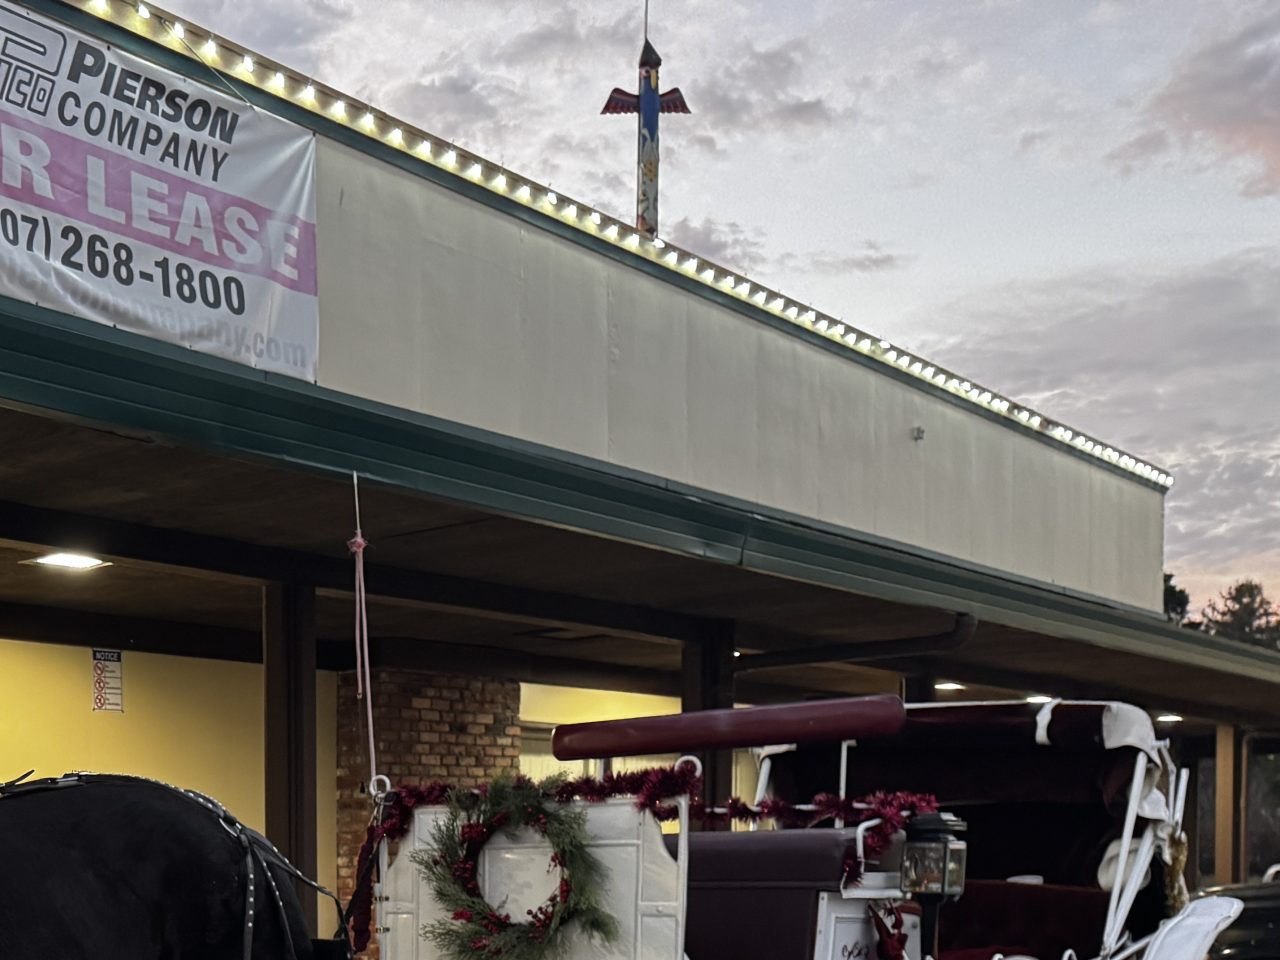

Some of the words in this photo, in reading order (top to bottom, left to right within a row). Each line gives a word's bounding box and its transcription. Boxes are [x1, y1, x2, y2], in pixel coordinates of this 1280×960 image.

[58, 91, 229, 182] COMPANY
[67, 40, 239, 144] PIERSON
[86, 153, 300, 281] LEASE
[61, 225, 246, 315] 268-1800
[95, 651, 119, 661] NOTICE
